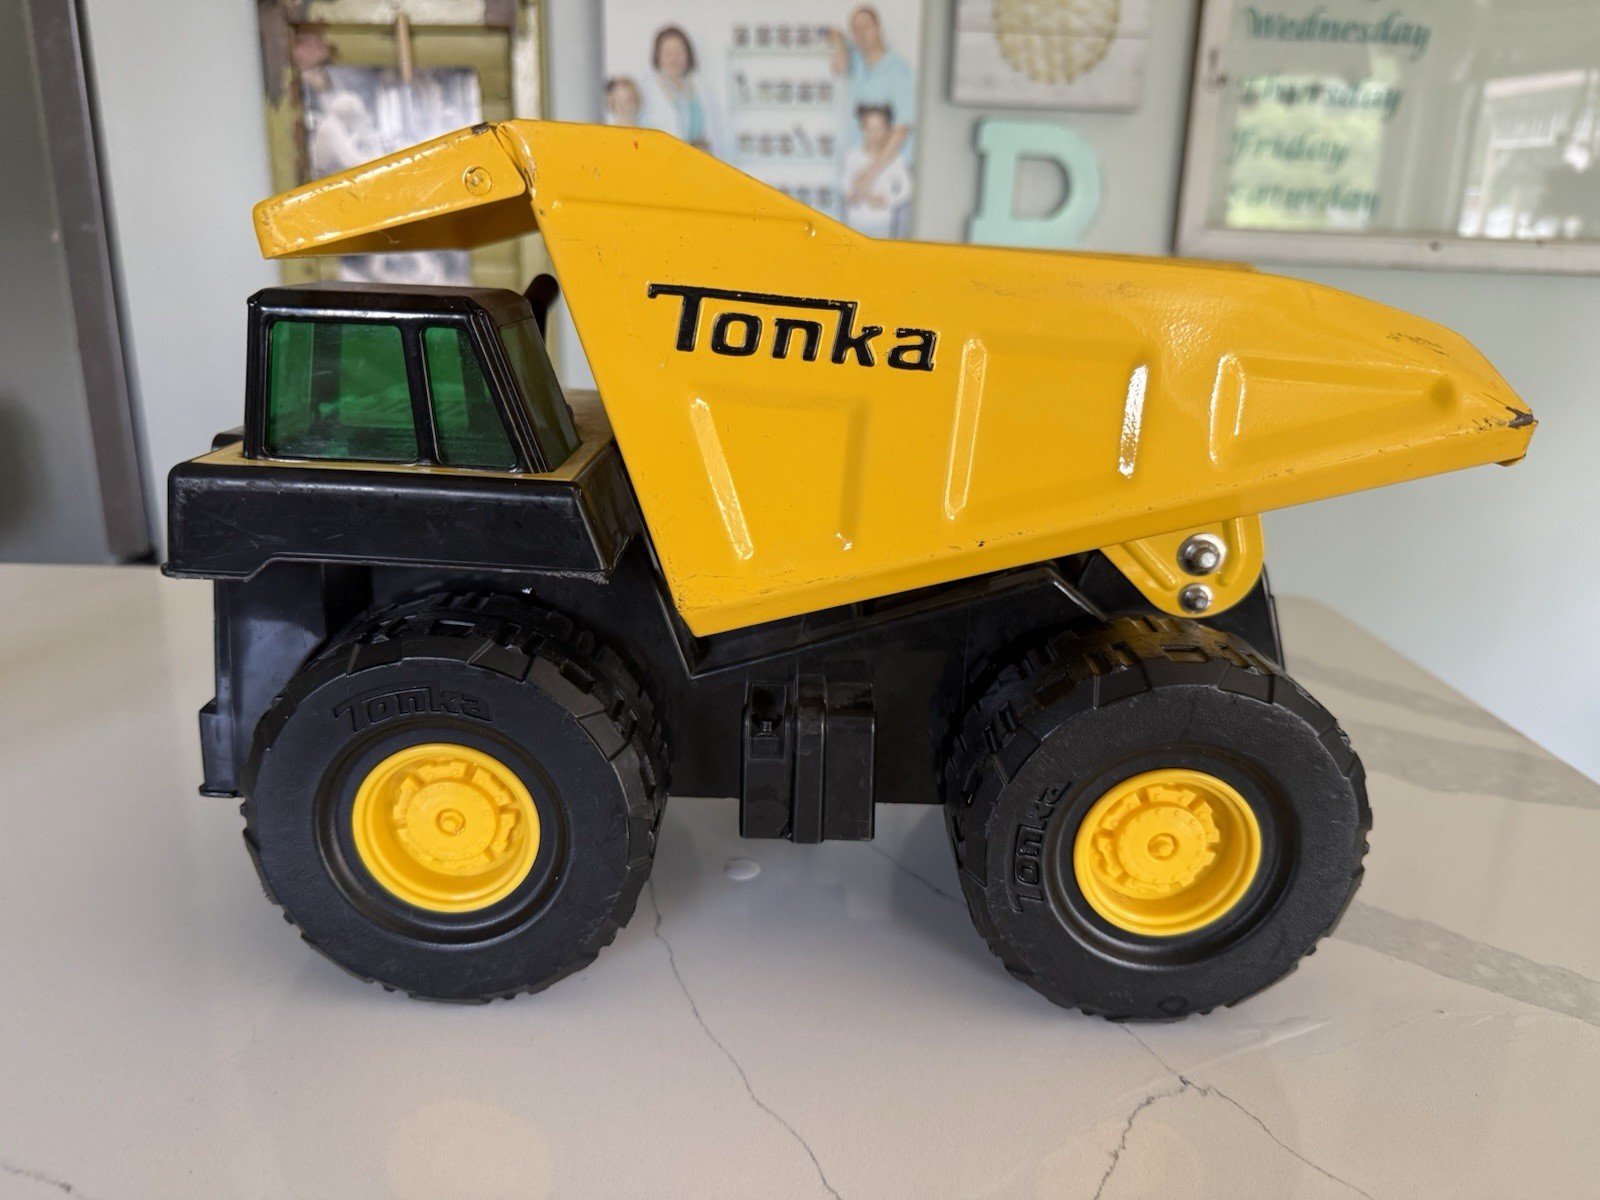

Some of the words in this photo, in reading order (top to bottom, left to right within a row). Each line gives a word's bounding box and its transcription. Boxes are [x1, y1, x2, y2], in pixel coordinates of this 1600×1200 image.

[1245, 6, 1432, 62] Wednesday
[967, 116, 1101, 247] D
[1228, 127, 1351, 174] Friday
[648, 283, 937, 371] Tonka
[333, 682, 493, 733] Tonka
[1005, 781, 1071, 912] Tonka
